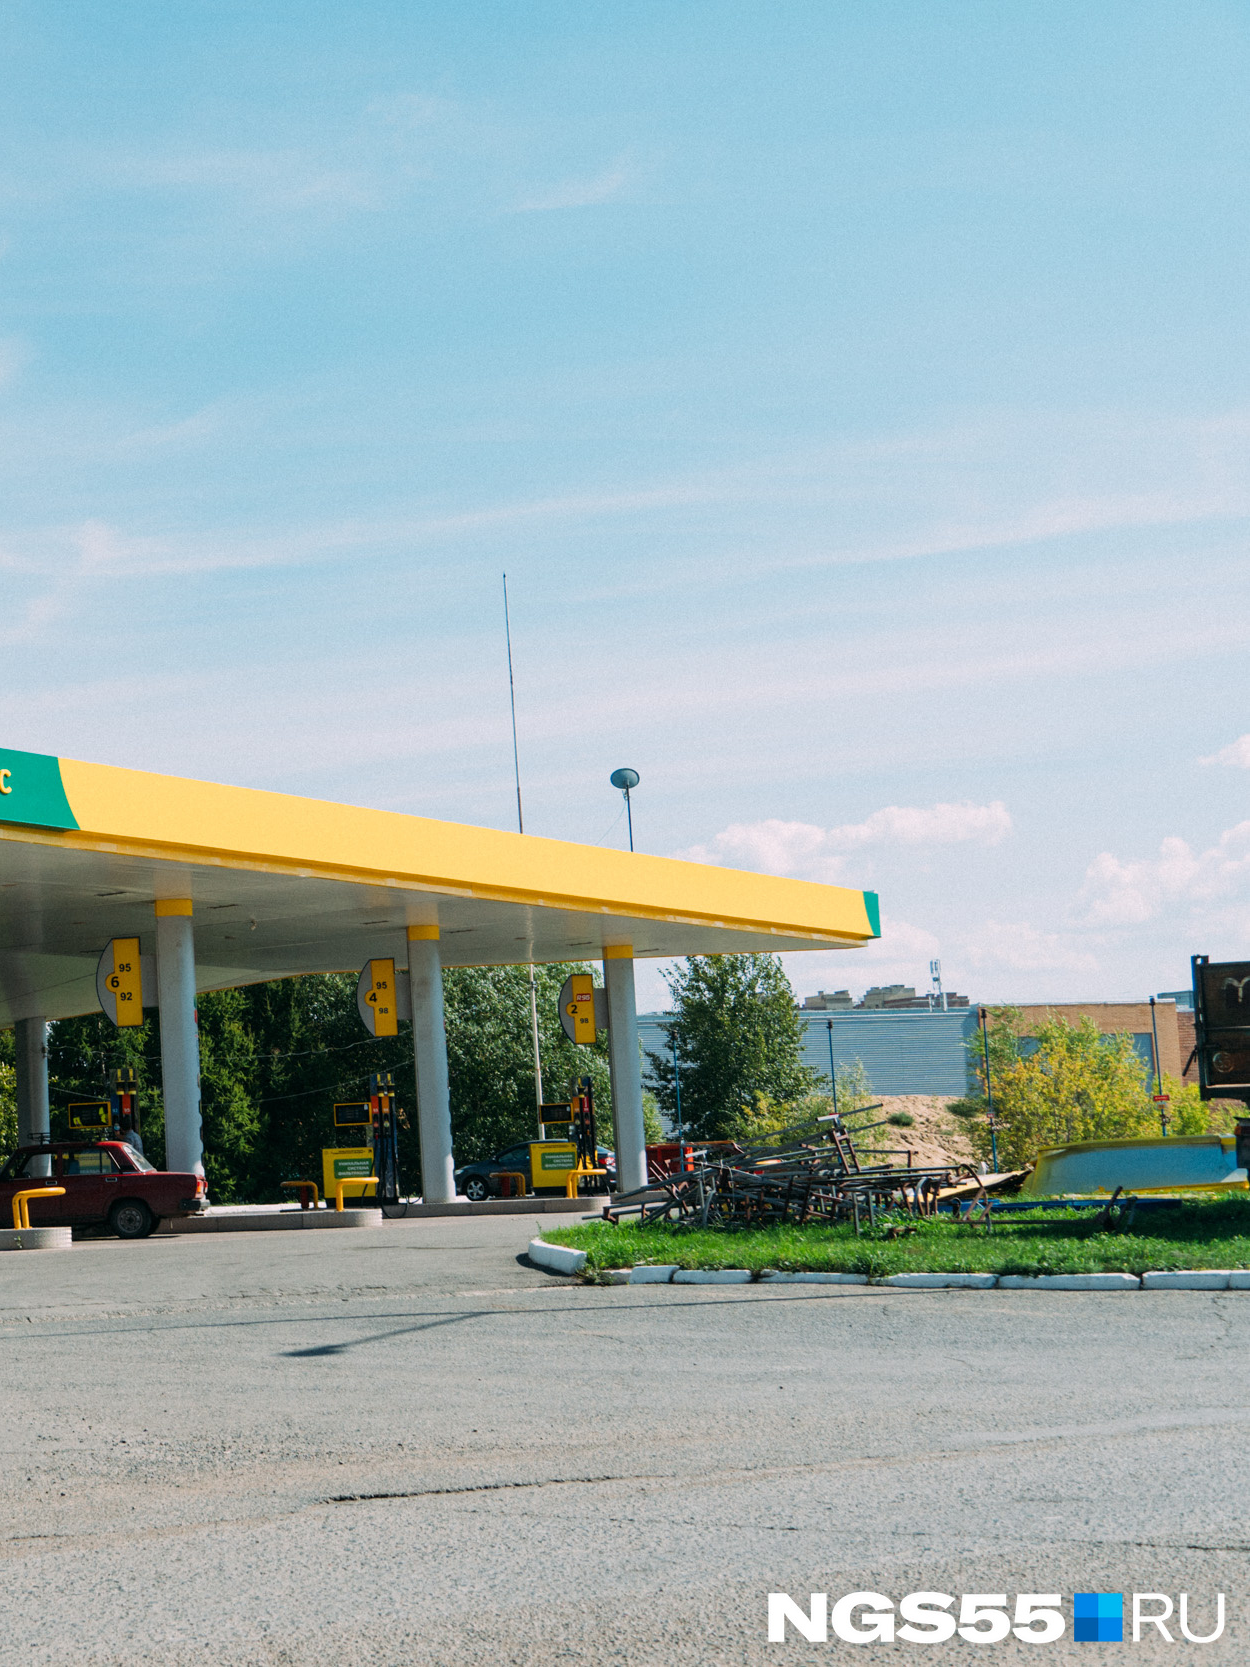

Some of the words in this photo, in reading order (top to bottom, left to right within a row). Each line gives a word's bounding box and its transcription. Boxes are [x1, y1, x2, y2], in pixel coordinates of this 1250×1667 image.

[118, 964, 131, 972] 95
[111, 976, 120, 988] 6
[120, 992, 133, 1001] 92
[369, 992, 378, 1002] 4
[571, 1004, 578, 1014] 2
